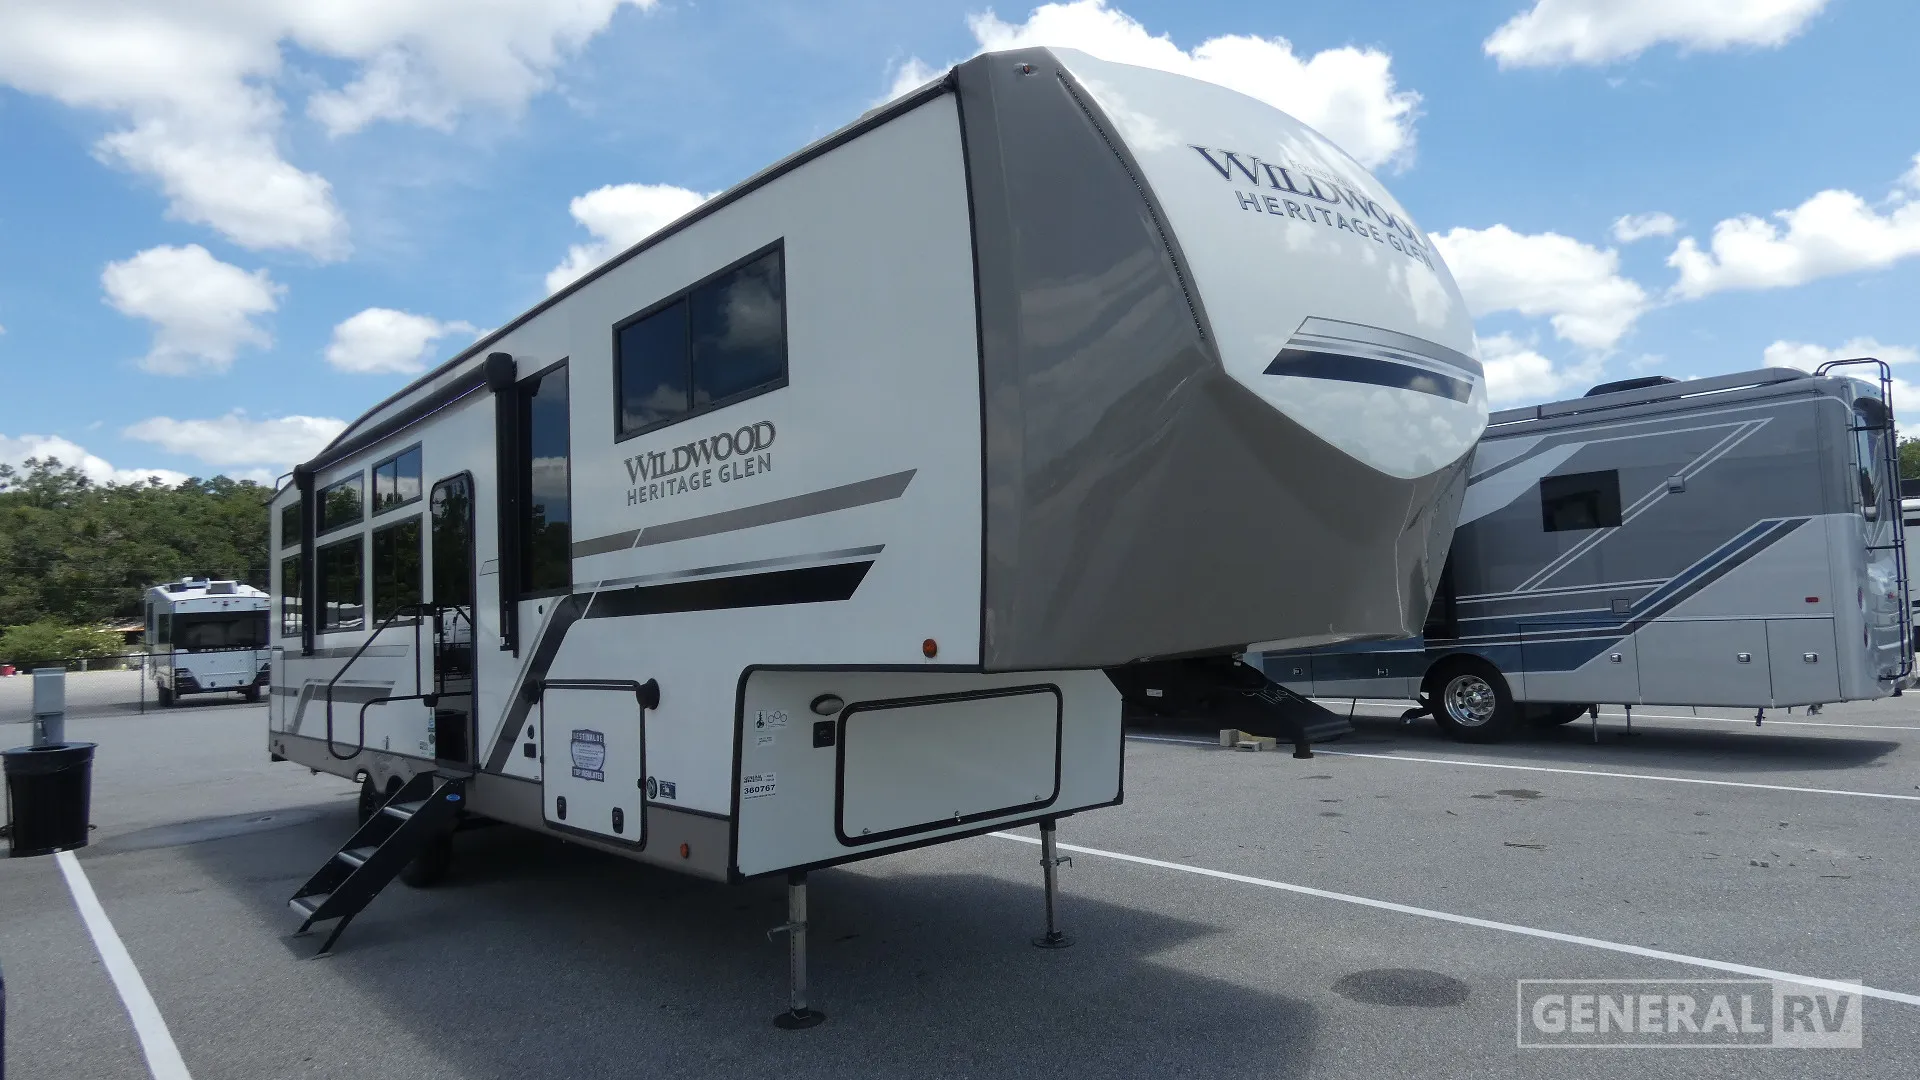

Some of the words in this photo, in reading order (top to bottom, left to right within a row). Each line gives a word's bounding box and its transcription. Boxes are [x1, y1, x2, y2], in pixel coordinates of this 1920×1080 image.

[1187, 144, 1429, 251] WILDWOOD
[1235, 190, 1384, 243] HERITAGE
[1387, 232, 1435, 271] GLEN
[623, 420, 777, 485] WILDWOOD
[627, 469, 712, 506] HERITAGE
[718, 453, 771, 483] GLEN
[744, 784, 776, 795] 360767
